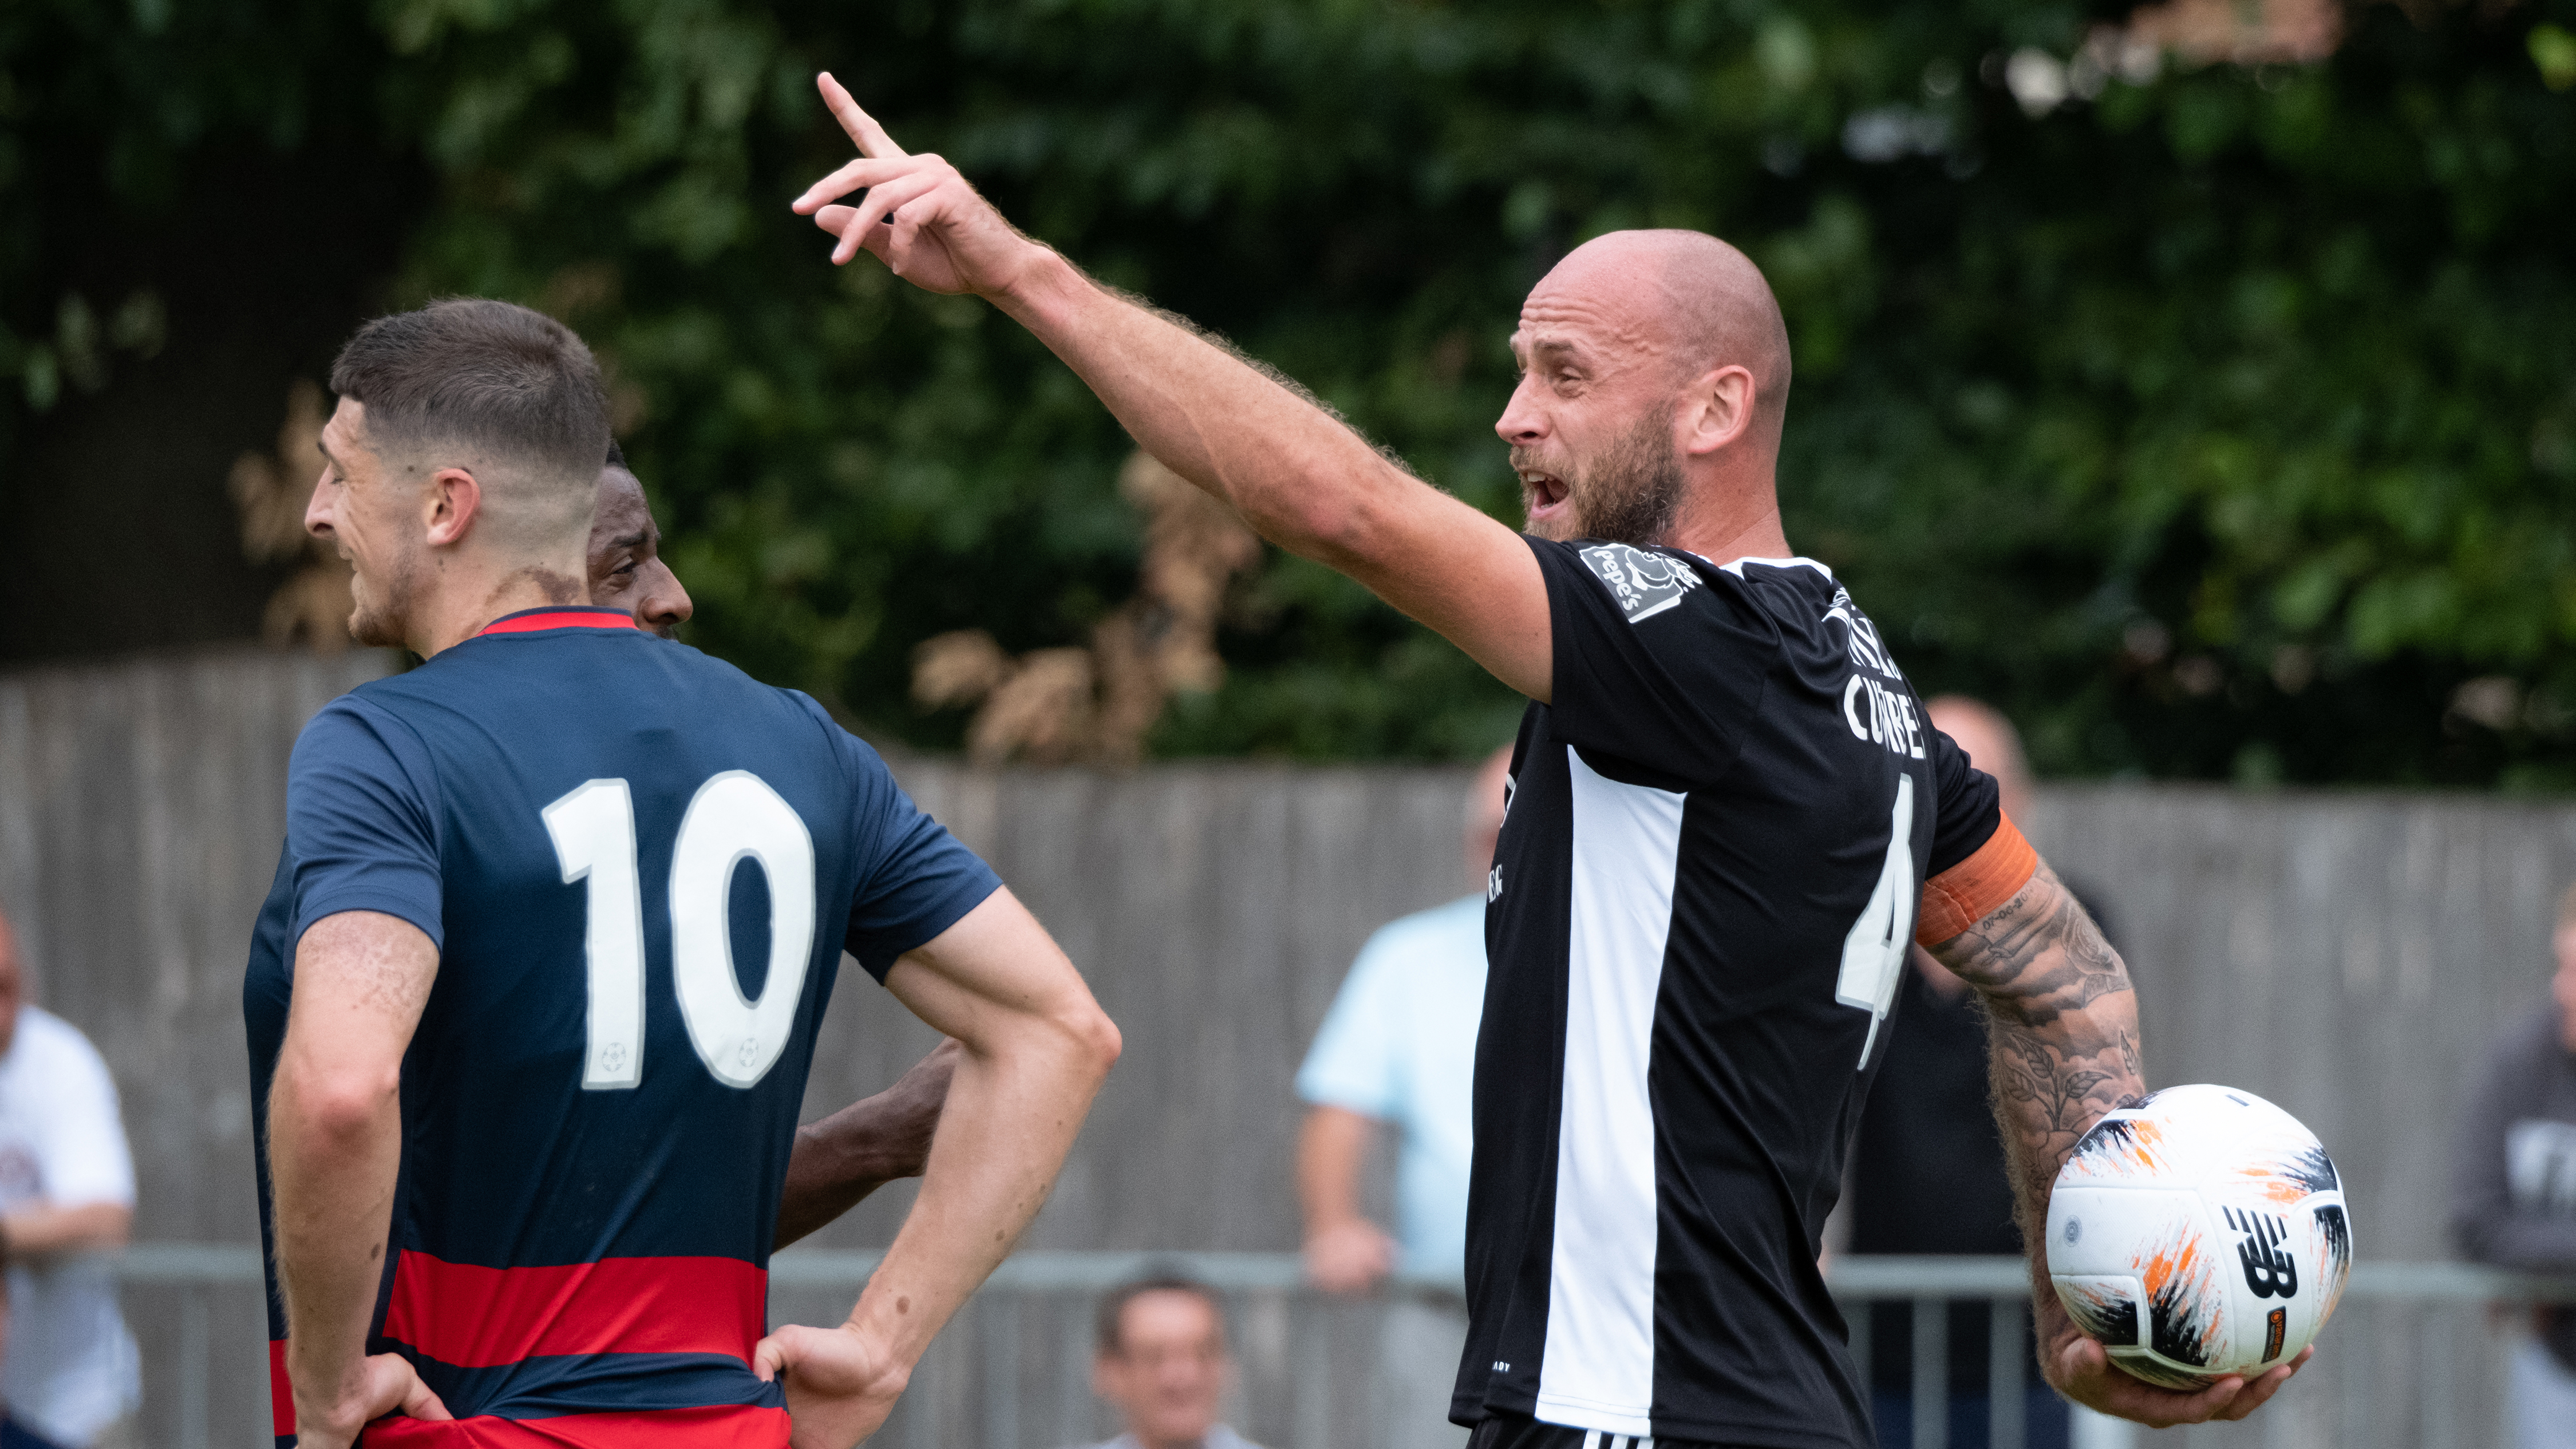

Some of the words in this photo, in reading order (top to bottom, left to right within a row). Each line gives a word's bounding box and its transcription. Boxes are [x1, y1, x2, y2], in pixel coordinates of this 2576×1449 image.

[541, 769, 816, 1090] 10
[1835, 772, 1914, 1071] 4
[1492, 1361, 1510, 1372] ADY
